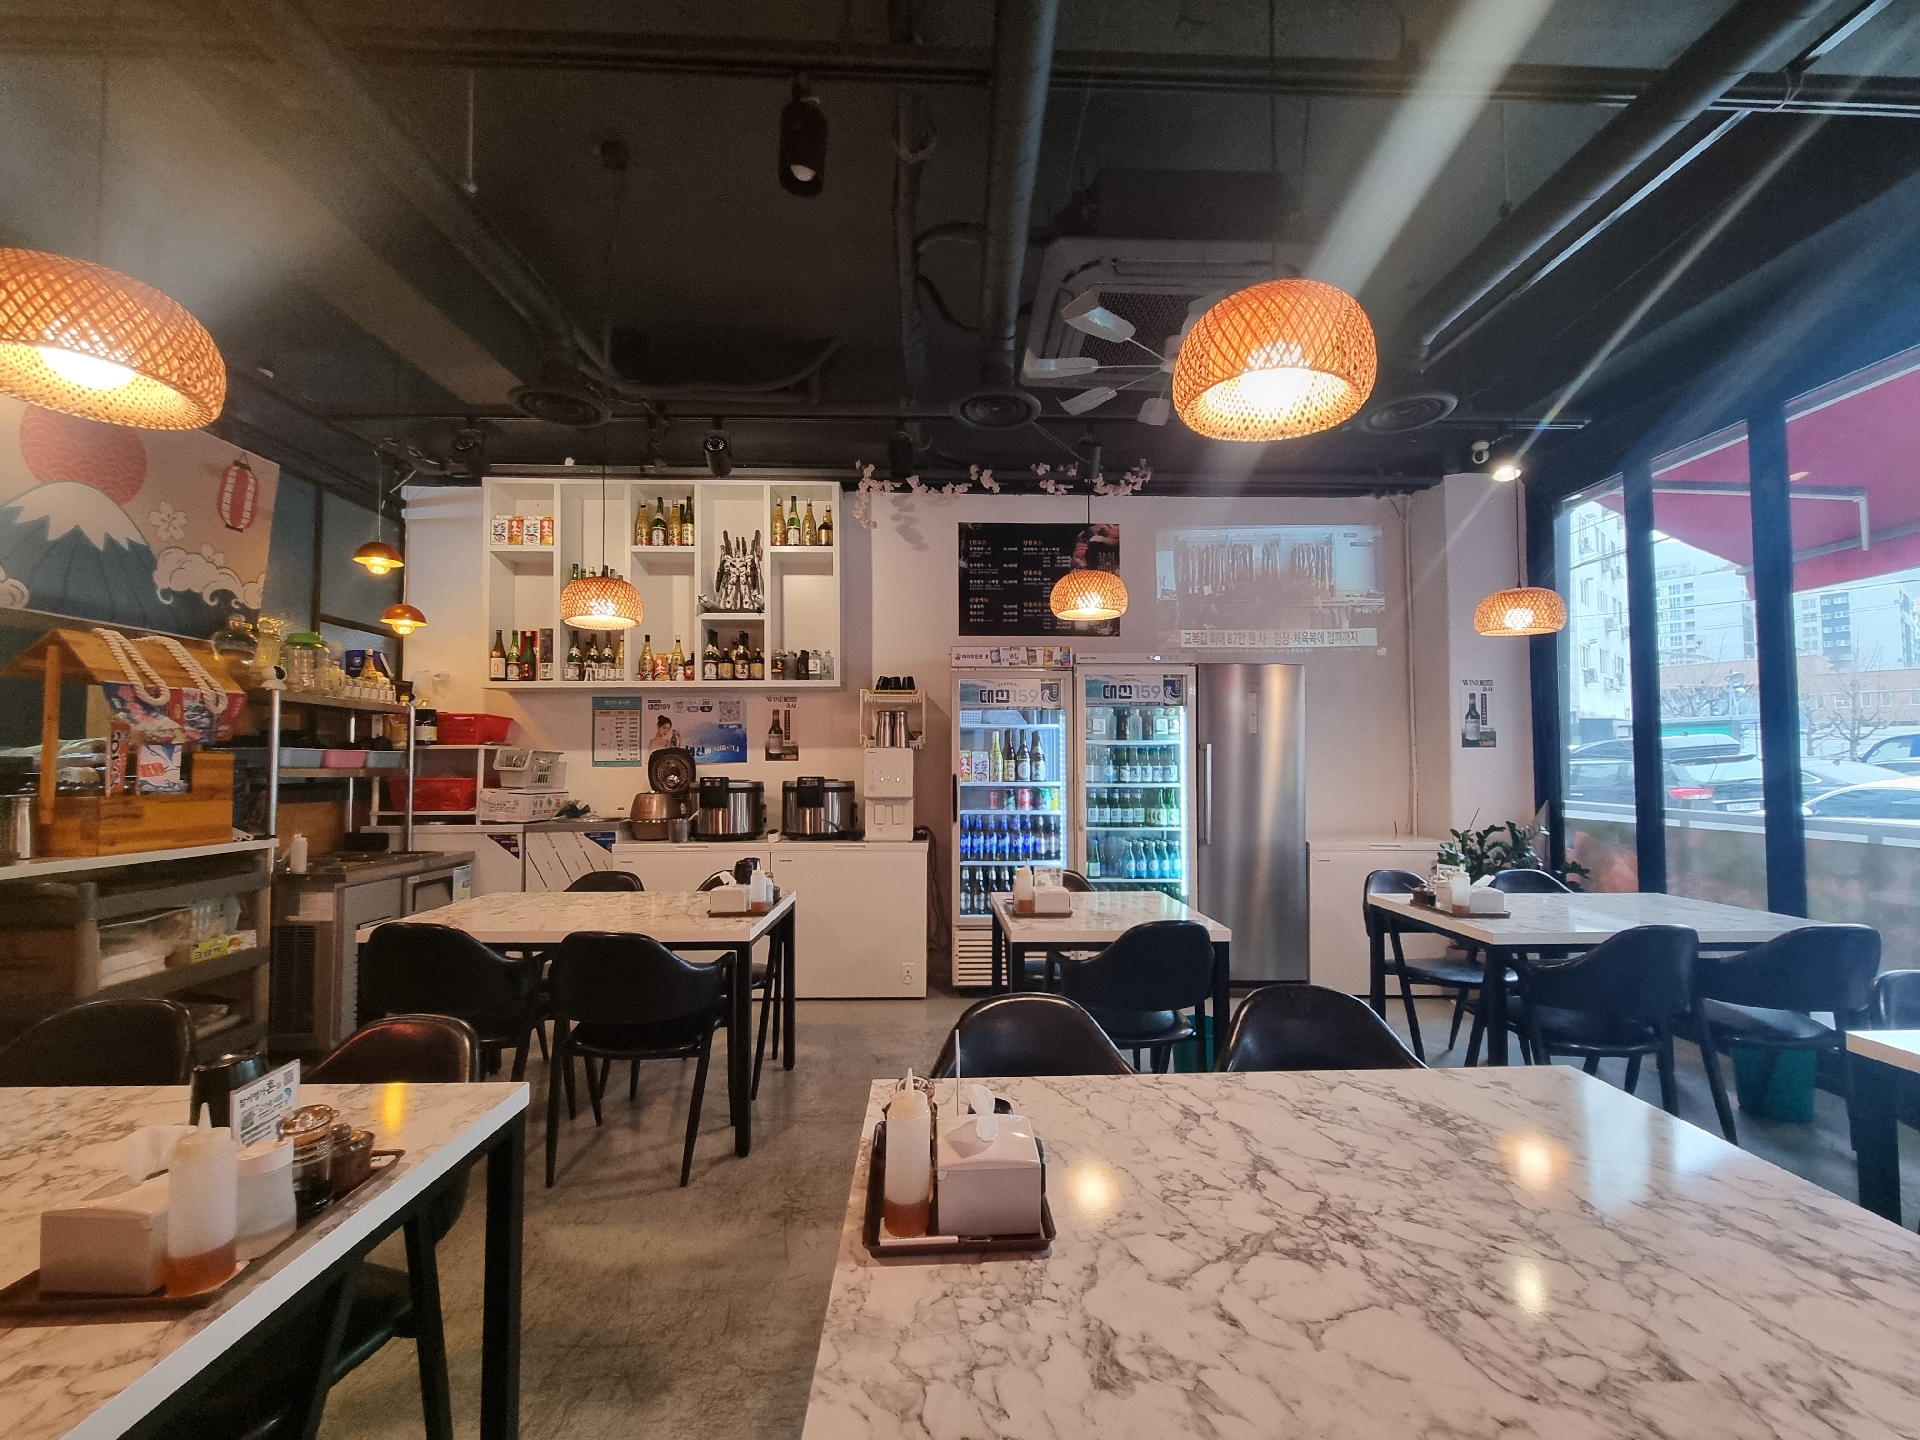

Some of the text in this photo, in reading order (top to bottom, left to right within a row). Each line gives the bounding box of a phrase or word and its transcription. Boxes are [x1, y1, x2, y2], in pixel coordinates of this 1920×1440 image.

[1183, 631, 1208, 646] 교복값
[1227, 631, 1246, 645] 87만
[979, 689, 1039, 704] 대선159
[1102, 684, 1161, 699] 대선159
